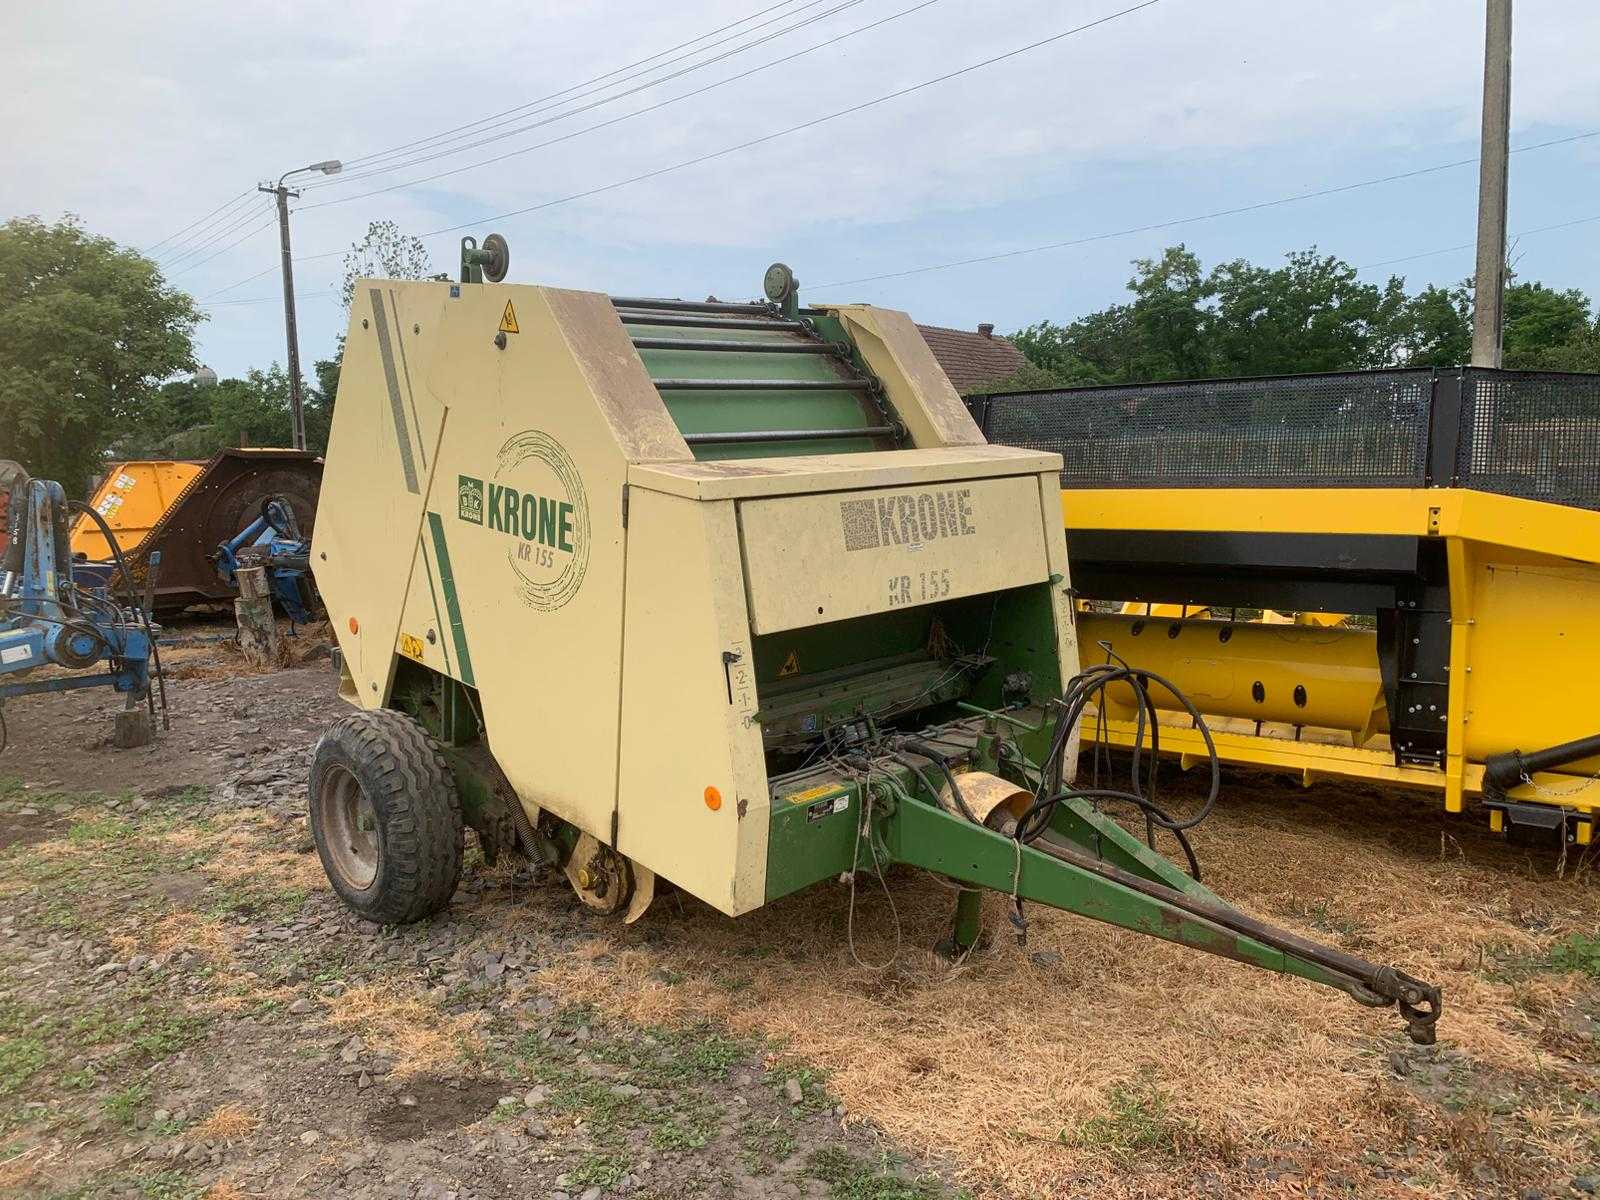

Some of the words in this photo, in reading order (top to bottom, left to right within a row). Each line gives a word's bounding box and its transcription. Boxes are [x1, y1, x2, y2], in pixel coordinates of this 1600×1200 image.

[488, 483, 574, 553] KRONE
[877, 488, 976, 546] KRONE
[517, 541, 531, 562] KR
[535, 547, 554, 568] 155
[888, 575, 913, 605] KR
[919, 567, 951, 600] 155
